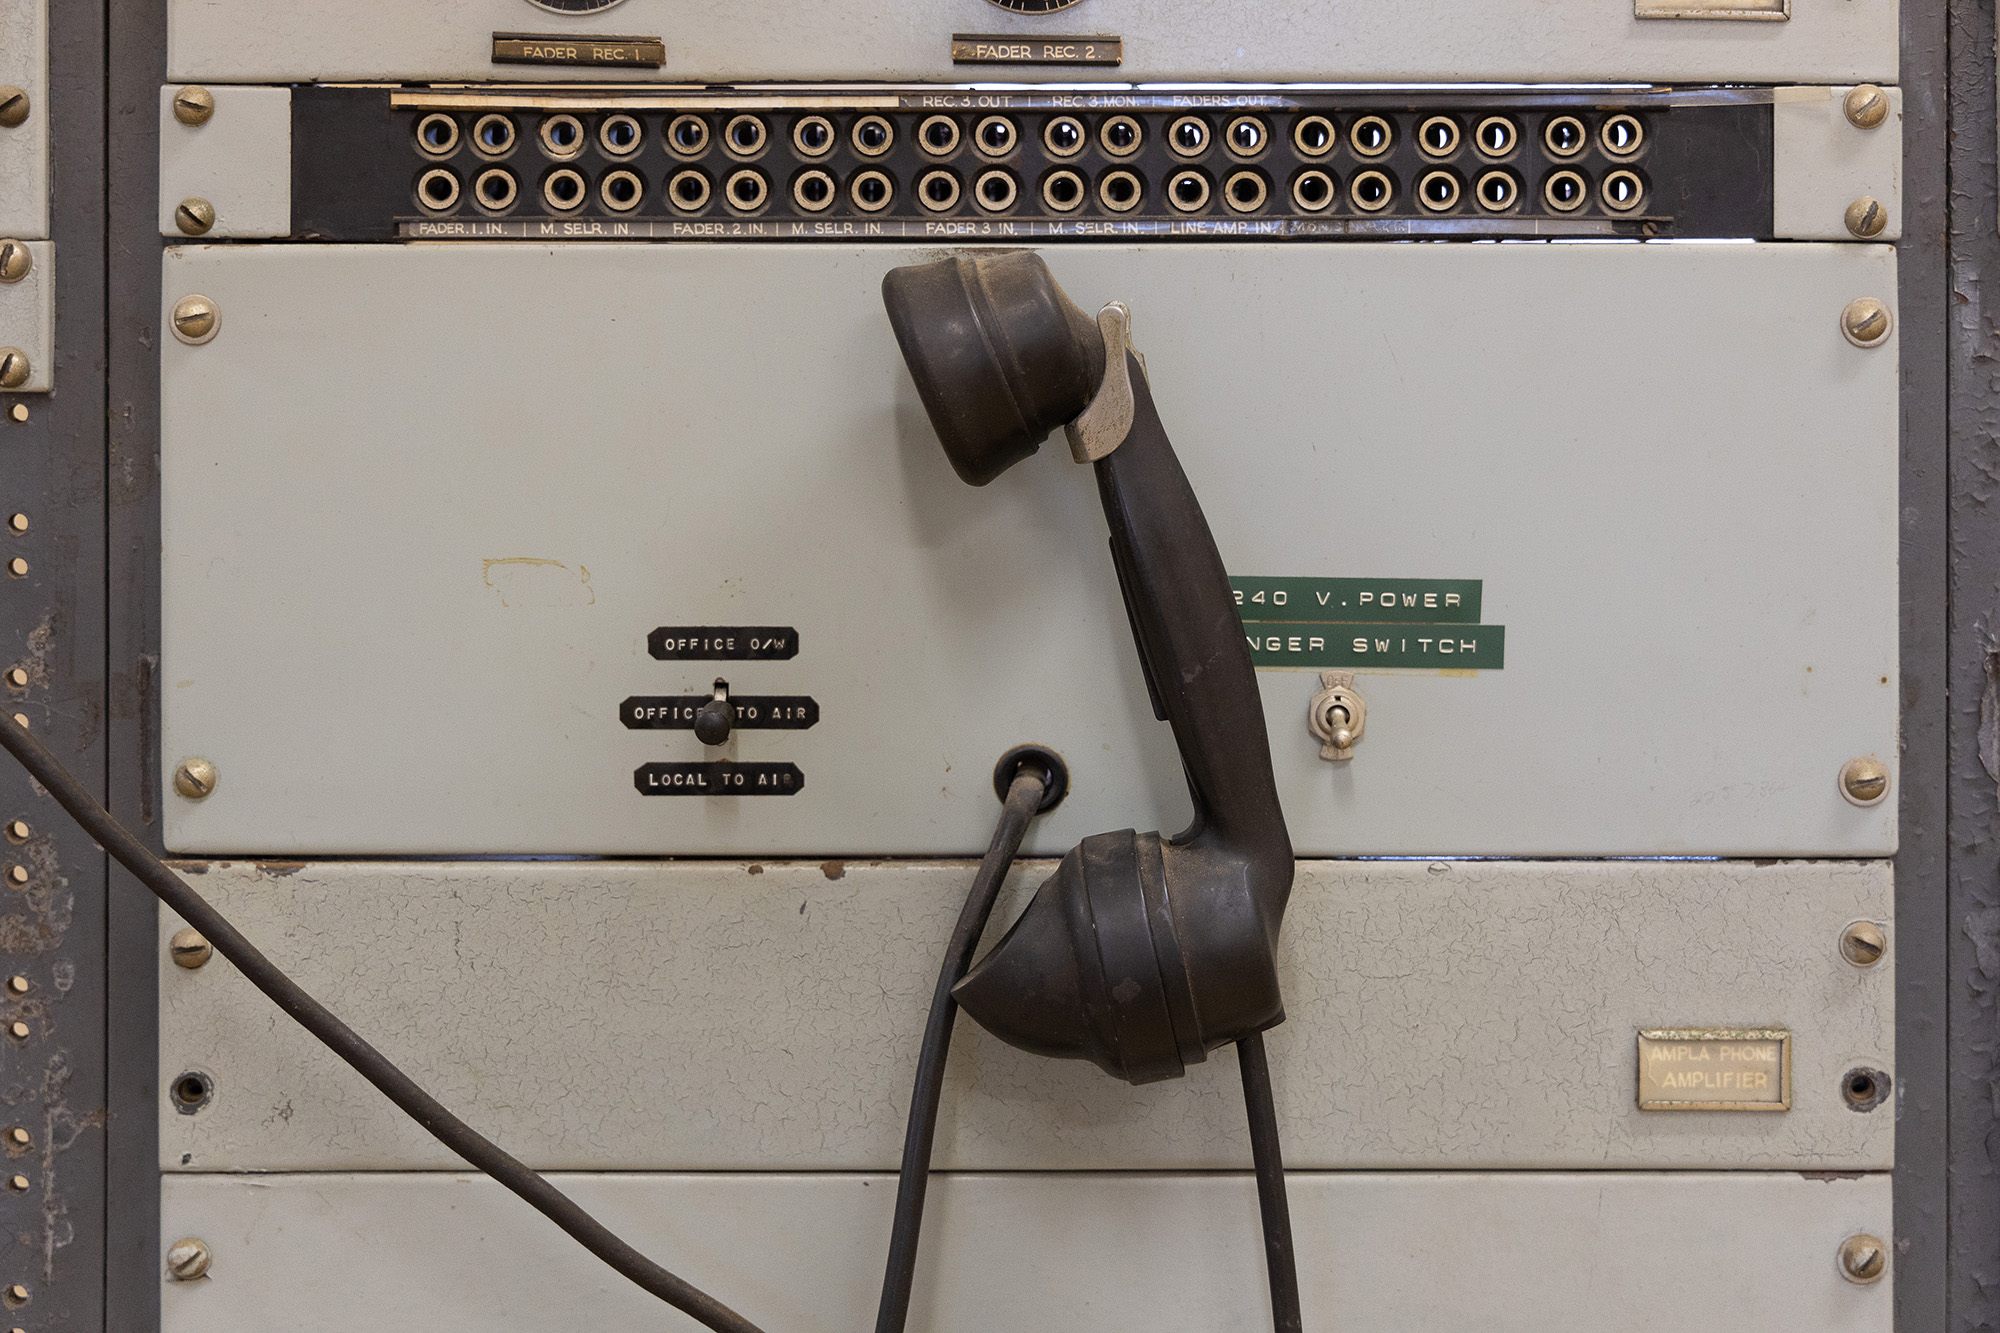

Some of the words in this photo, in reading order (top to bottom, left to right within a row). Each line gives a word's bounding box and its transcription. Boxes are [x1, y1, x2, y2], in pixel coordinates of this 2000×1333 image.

[523, 46, 577, 60] FADER
[976, 45, 1032, 58] FADER
[1173, 96, 1230, 107] FADERS
[540, 223, 558, 235] M.
[564, 223, 608, 235] SELR.
[792, 223, 808, 235] M.
[814, 223, 859, 235] SELR.
[926, 222, 977, 234] FADER
[981, 222, 991, 234] 3
[1170, 221, 1207, 234] LINE
[1232, 590, 1288, 606] 240
[665, 638, 735, 651] OFFICE
[1246, 636, 1325, 652] NGER
[1352, 638, 1476, 654] SWITCH
[736, 707, 757, 719] TO
[772, 707, 806, 719] AIR
[649, 773, 707, 786] LOCAL
[723, 773, 744, 786] TO
[1720, 1046, 1777, 1062] PHONE
[1662, 1071, 1768, 1088] AMPLIFIER
